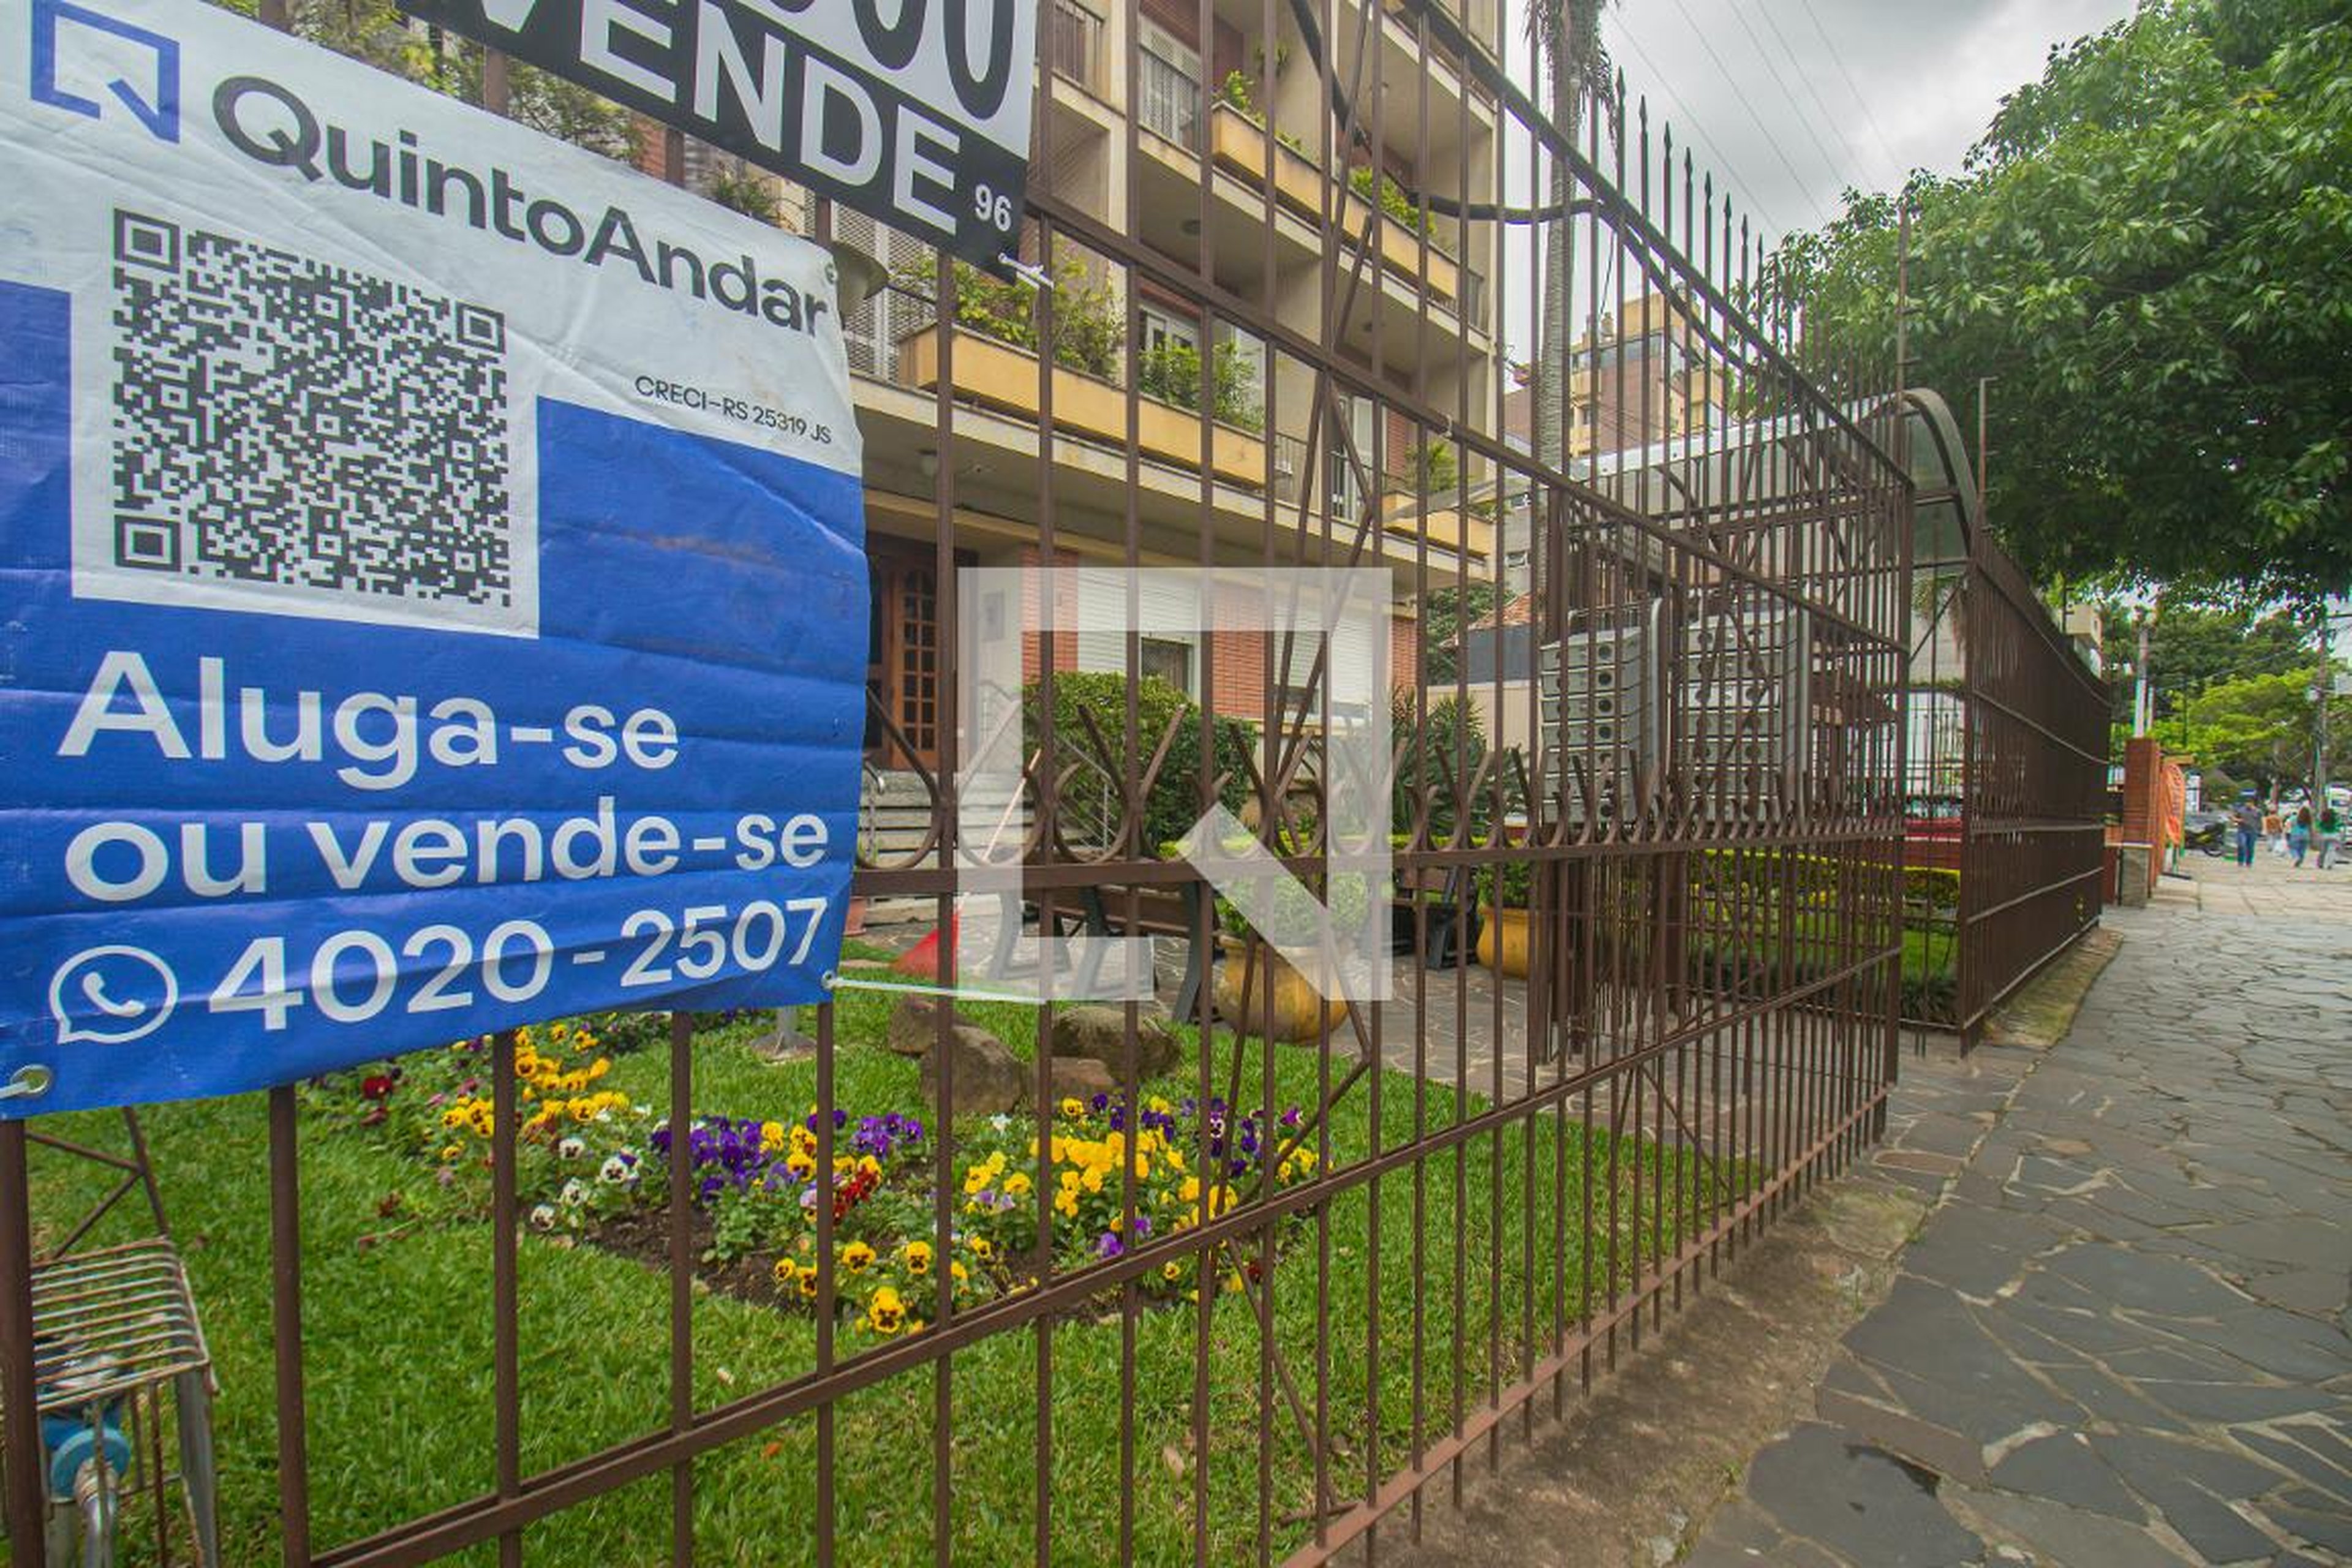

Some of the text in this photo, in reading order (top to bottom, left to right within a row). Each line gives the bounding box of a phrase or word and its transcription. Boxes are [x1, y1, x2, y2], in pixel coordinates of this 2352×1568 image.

[483, 0, 960, 235] ENDE
[212, 75, 827, 336] QuintoAndar
[975, 184, 1012, 232] 96
[635, 375, 832, 444] CRECI-RS 25319 JS
[57, 650, 679, 790] Aluga-se
[65, 796, 829, 902] ou vende-se
